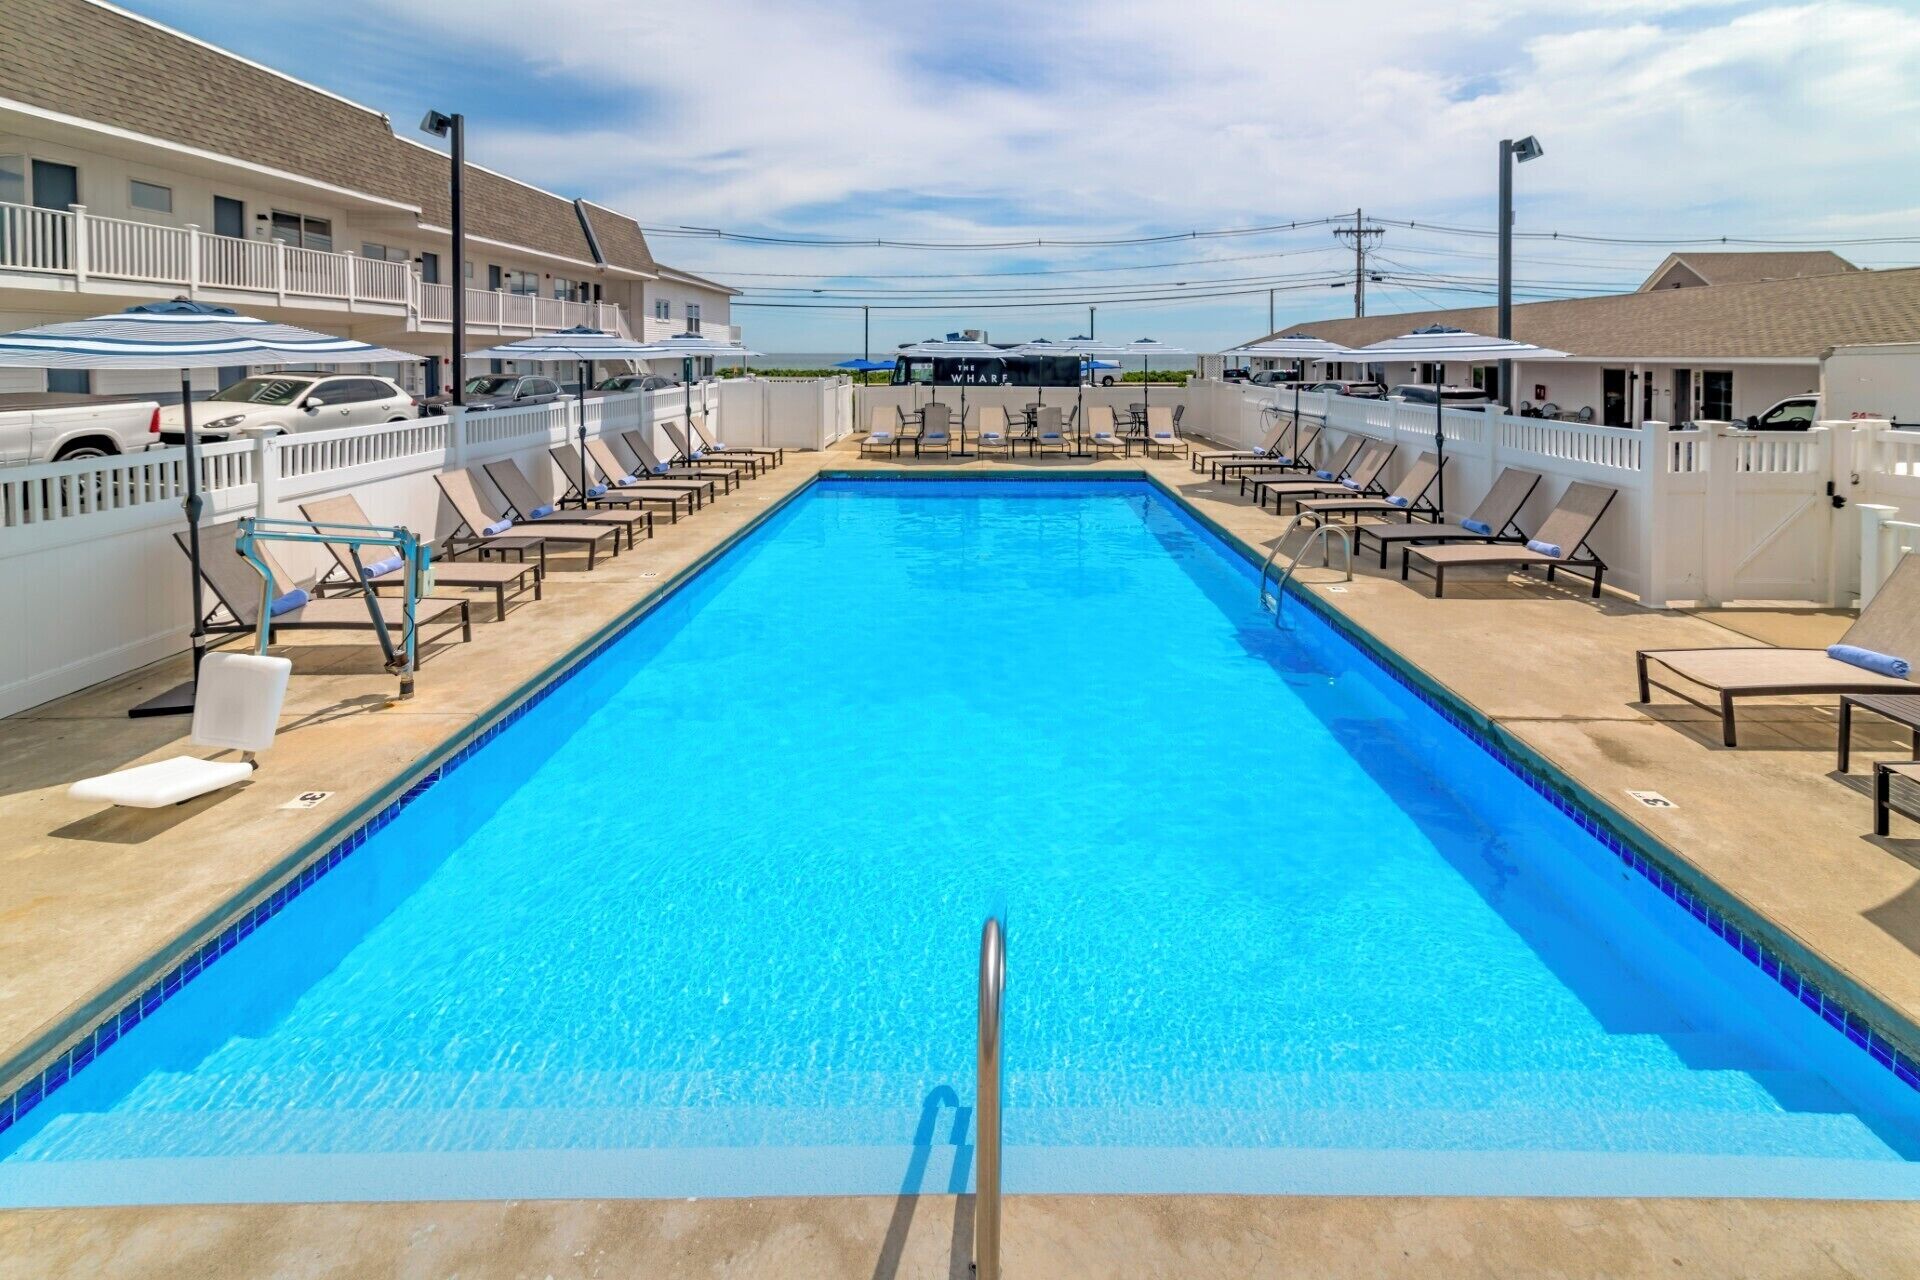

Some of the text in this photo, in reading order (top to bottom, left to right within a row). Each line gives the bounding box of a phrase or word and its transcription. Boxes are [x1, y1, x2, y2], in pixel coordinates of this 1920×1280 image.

[950, 374, 1008, 383] WHARF
[299, 792, 326, 801] 3
[1642, 798, 1671, 807] 3
